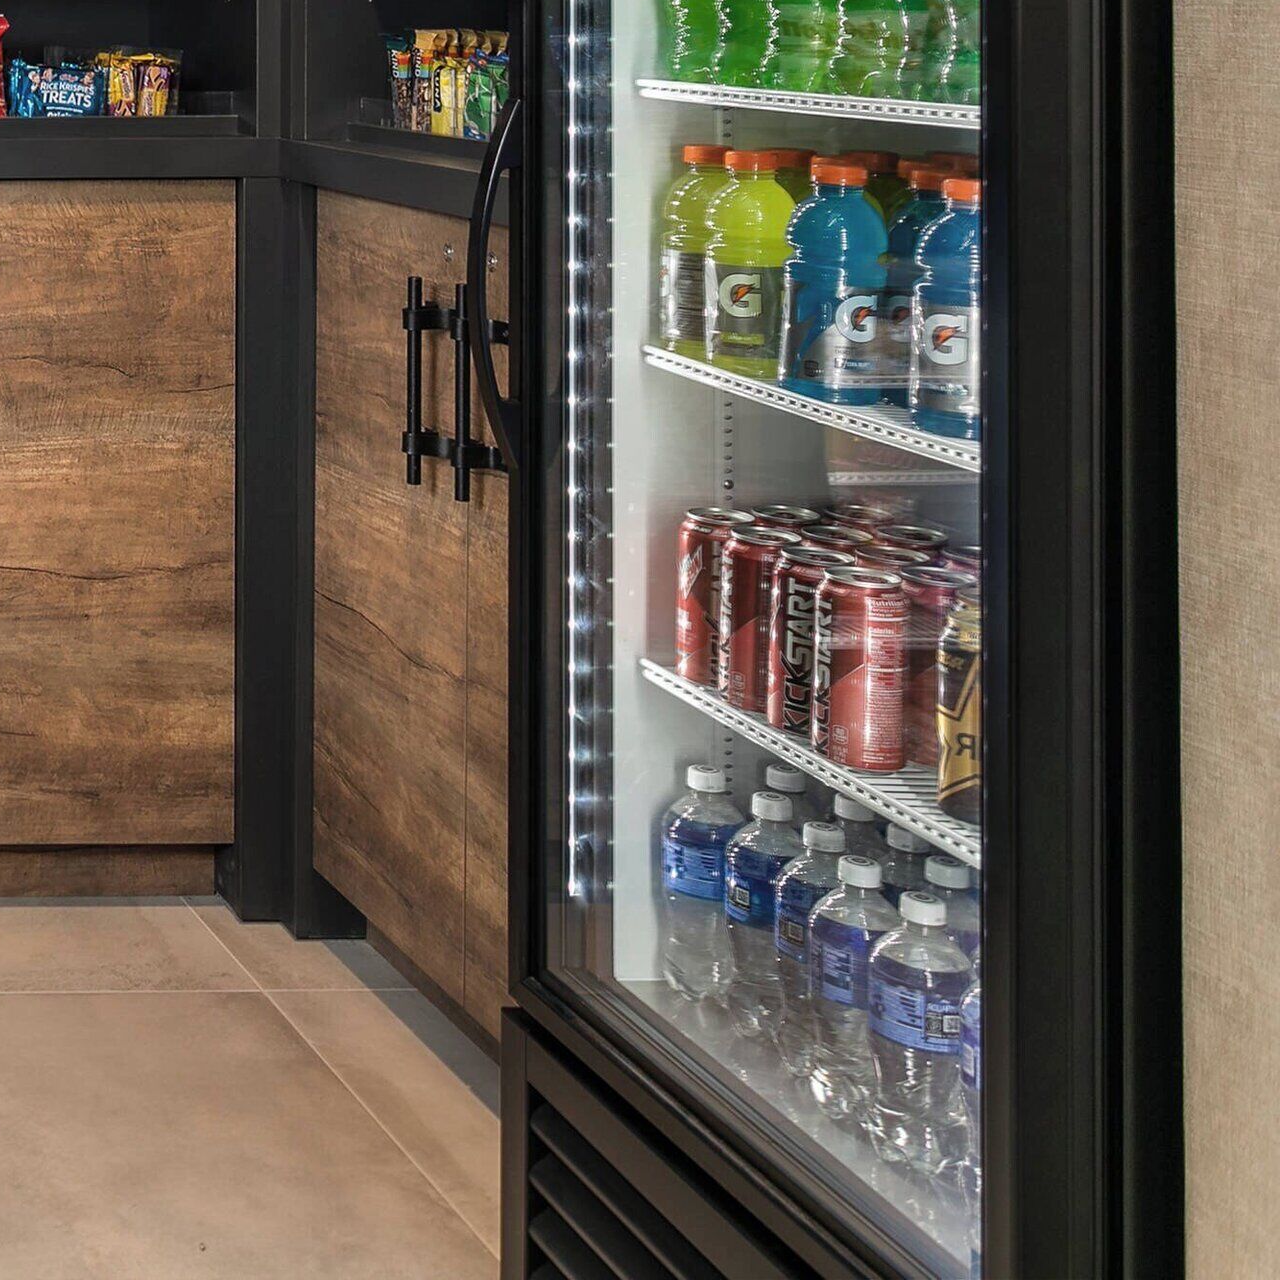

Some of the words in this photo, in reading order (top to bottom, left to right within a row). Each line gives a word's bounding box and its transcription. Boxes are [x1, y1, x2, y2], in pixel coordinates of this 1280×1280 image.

[391, 49, 400, 78] KIND
[414, 48, 424, 78] KIND
[40, 81, 59, 92] RICE
[59, 80, 95, 96] KRISPIES
[41, 90, 92, 109] TREATS
[718, 272, 762, 319] G
[836, 294, 879, 344] G
[923, 313, 969, 365] G
[782, 577, 811, 736] KICKSTART
[813, 598, 832, 756] KICKSTART
